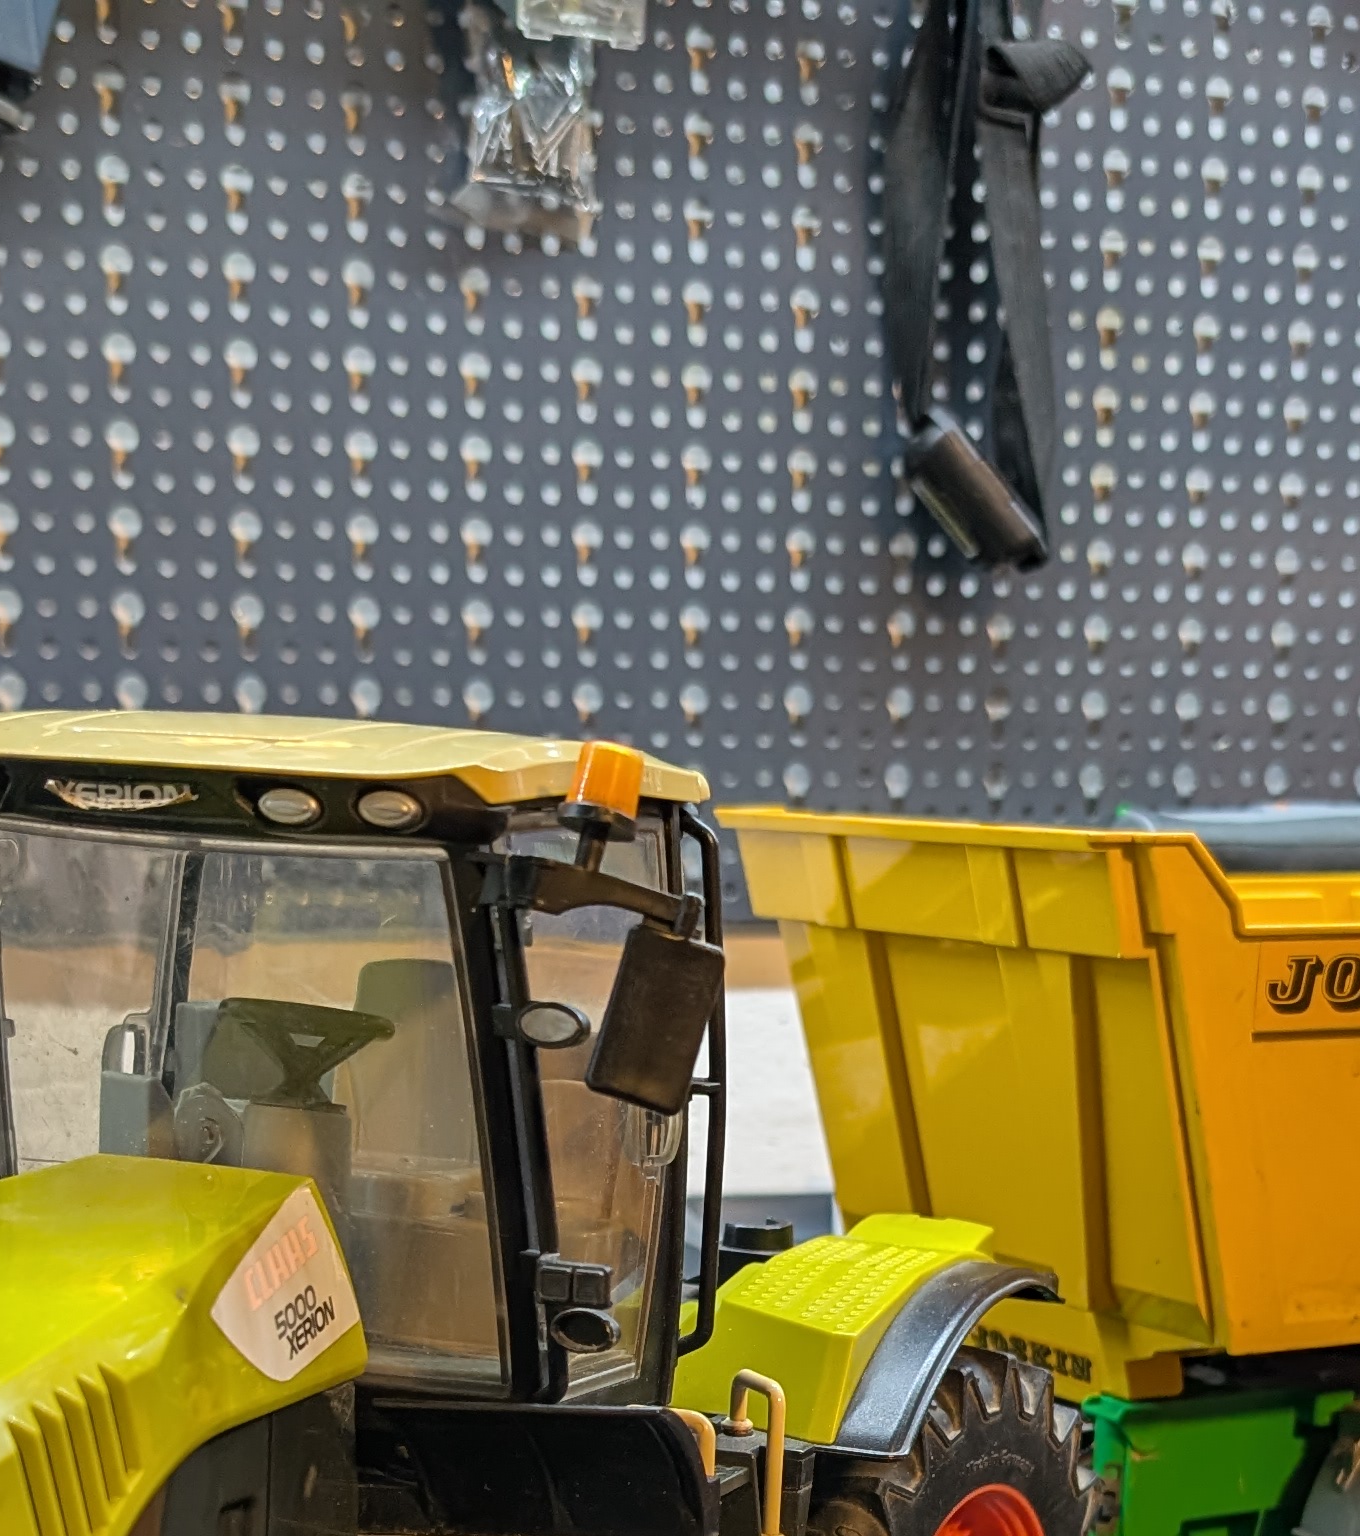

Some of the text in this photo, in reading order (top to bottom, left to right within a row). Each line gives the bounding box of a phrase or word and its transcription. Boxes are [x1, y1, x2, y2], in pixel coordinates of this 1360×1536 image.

[243, 1214, 319, 1311] CLAAS
[274, 1285, 317, 1340] 5000
[286, 1296, 336, 1360] XERION
